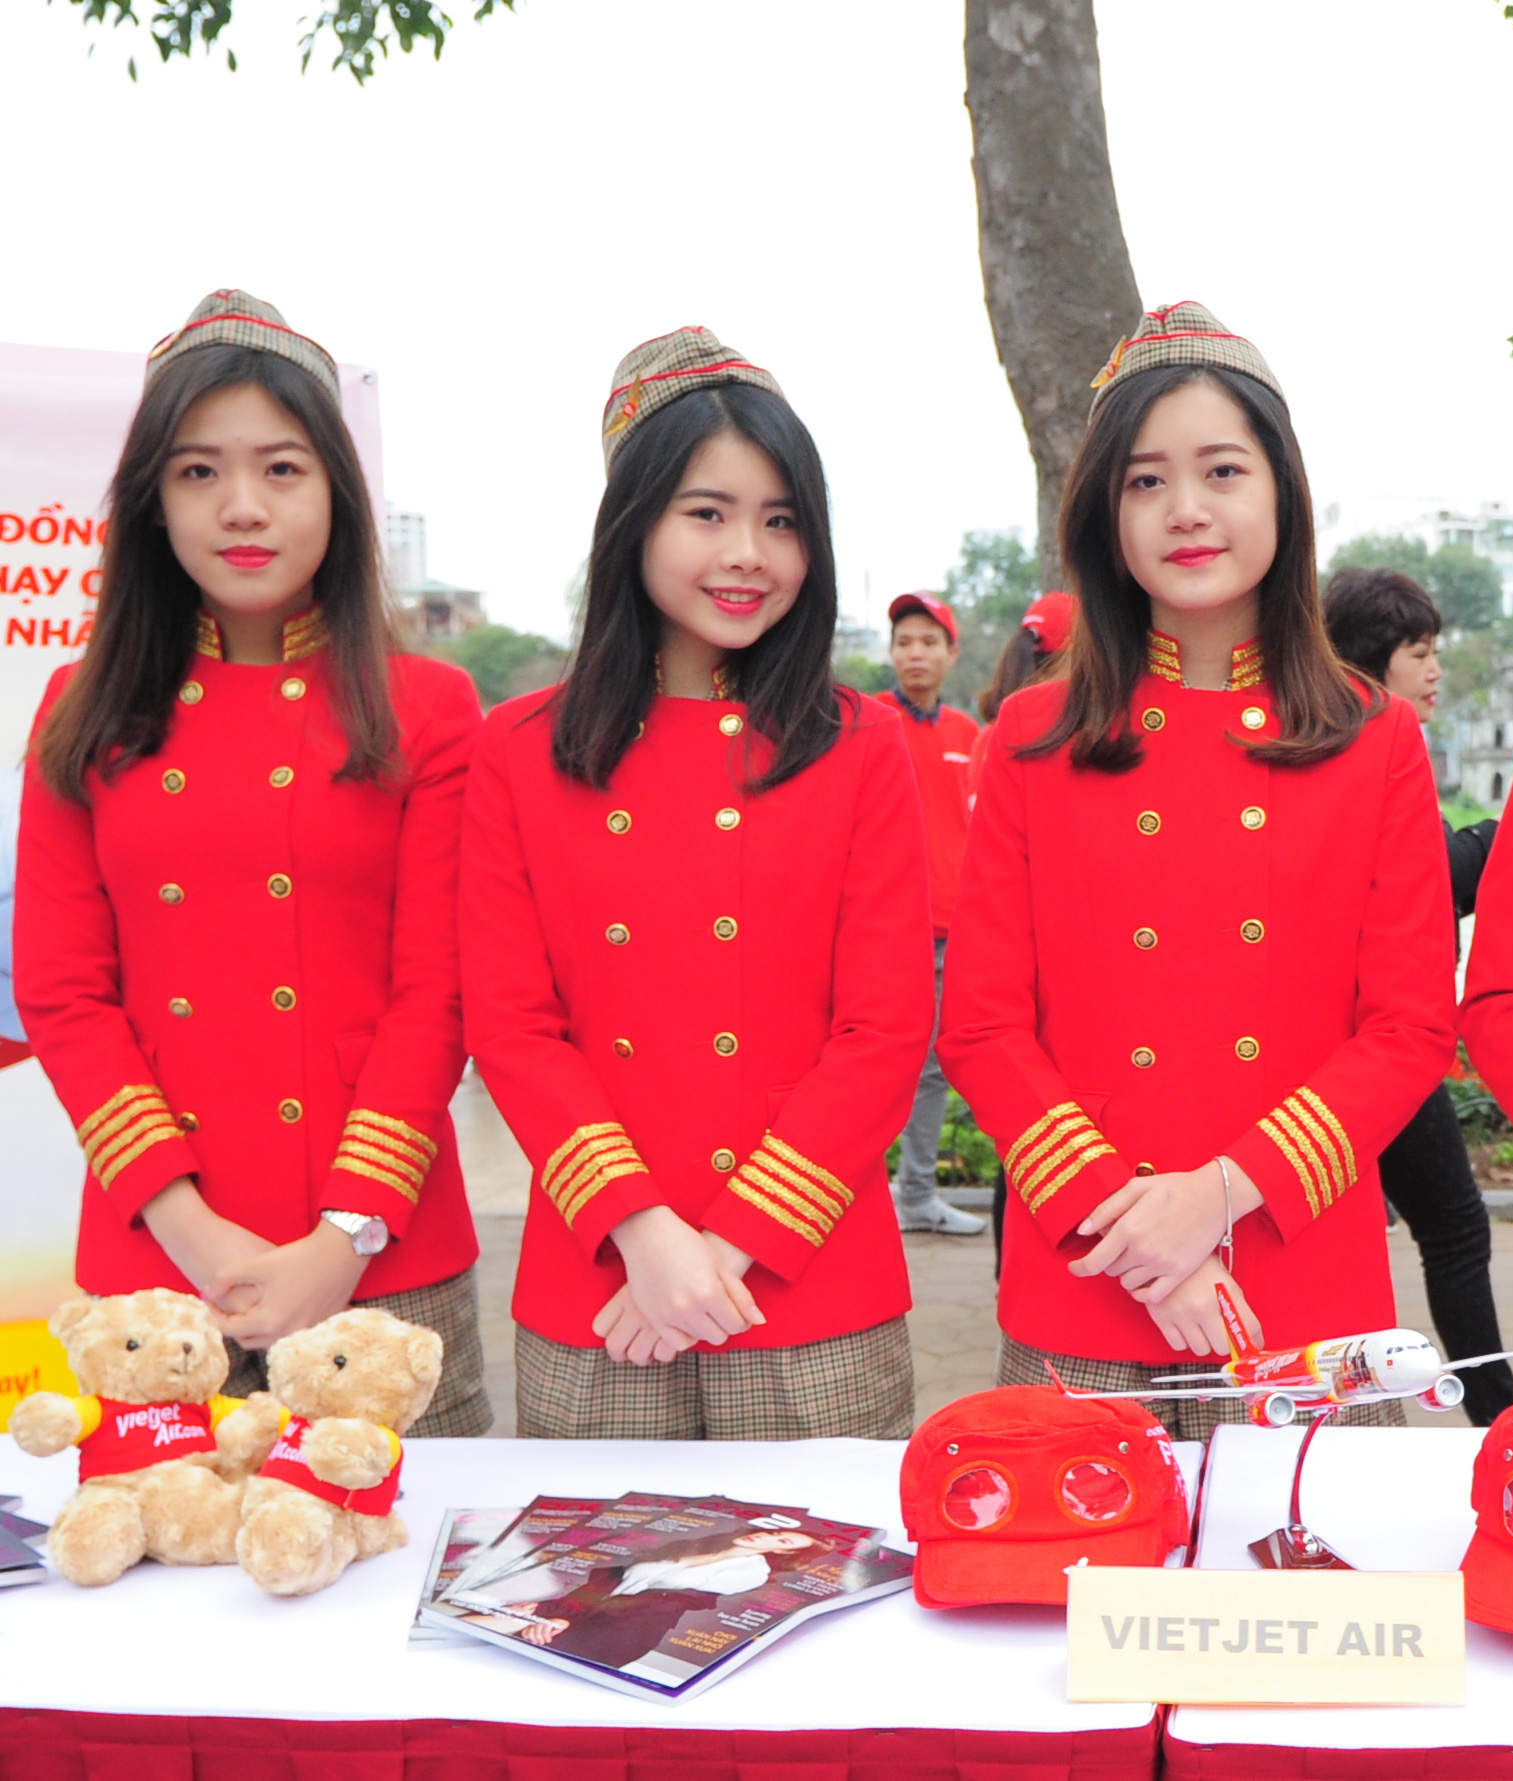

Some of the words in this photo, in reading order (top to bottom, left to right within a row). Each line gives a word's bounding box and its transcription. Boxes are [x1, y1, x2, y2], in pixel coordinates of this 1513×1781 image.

[6, 610, 96, 647] NHÂ
[1103, 1615, 1319, 1654] VIETJET
[1336, 1622, 1423, 1657] AIR
